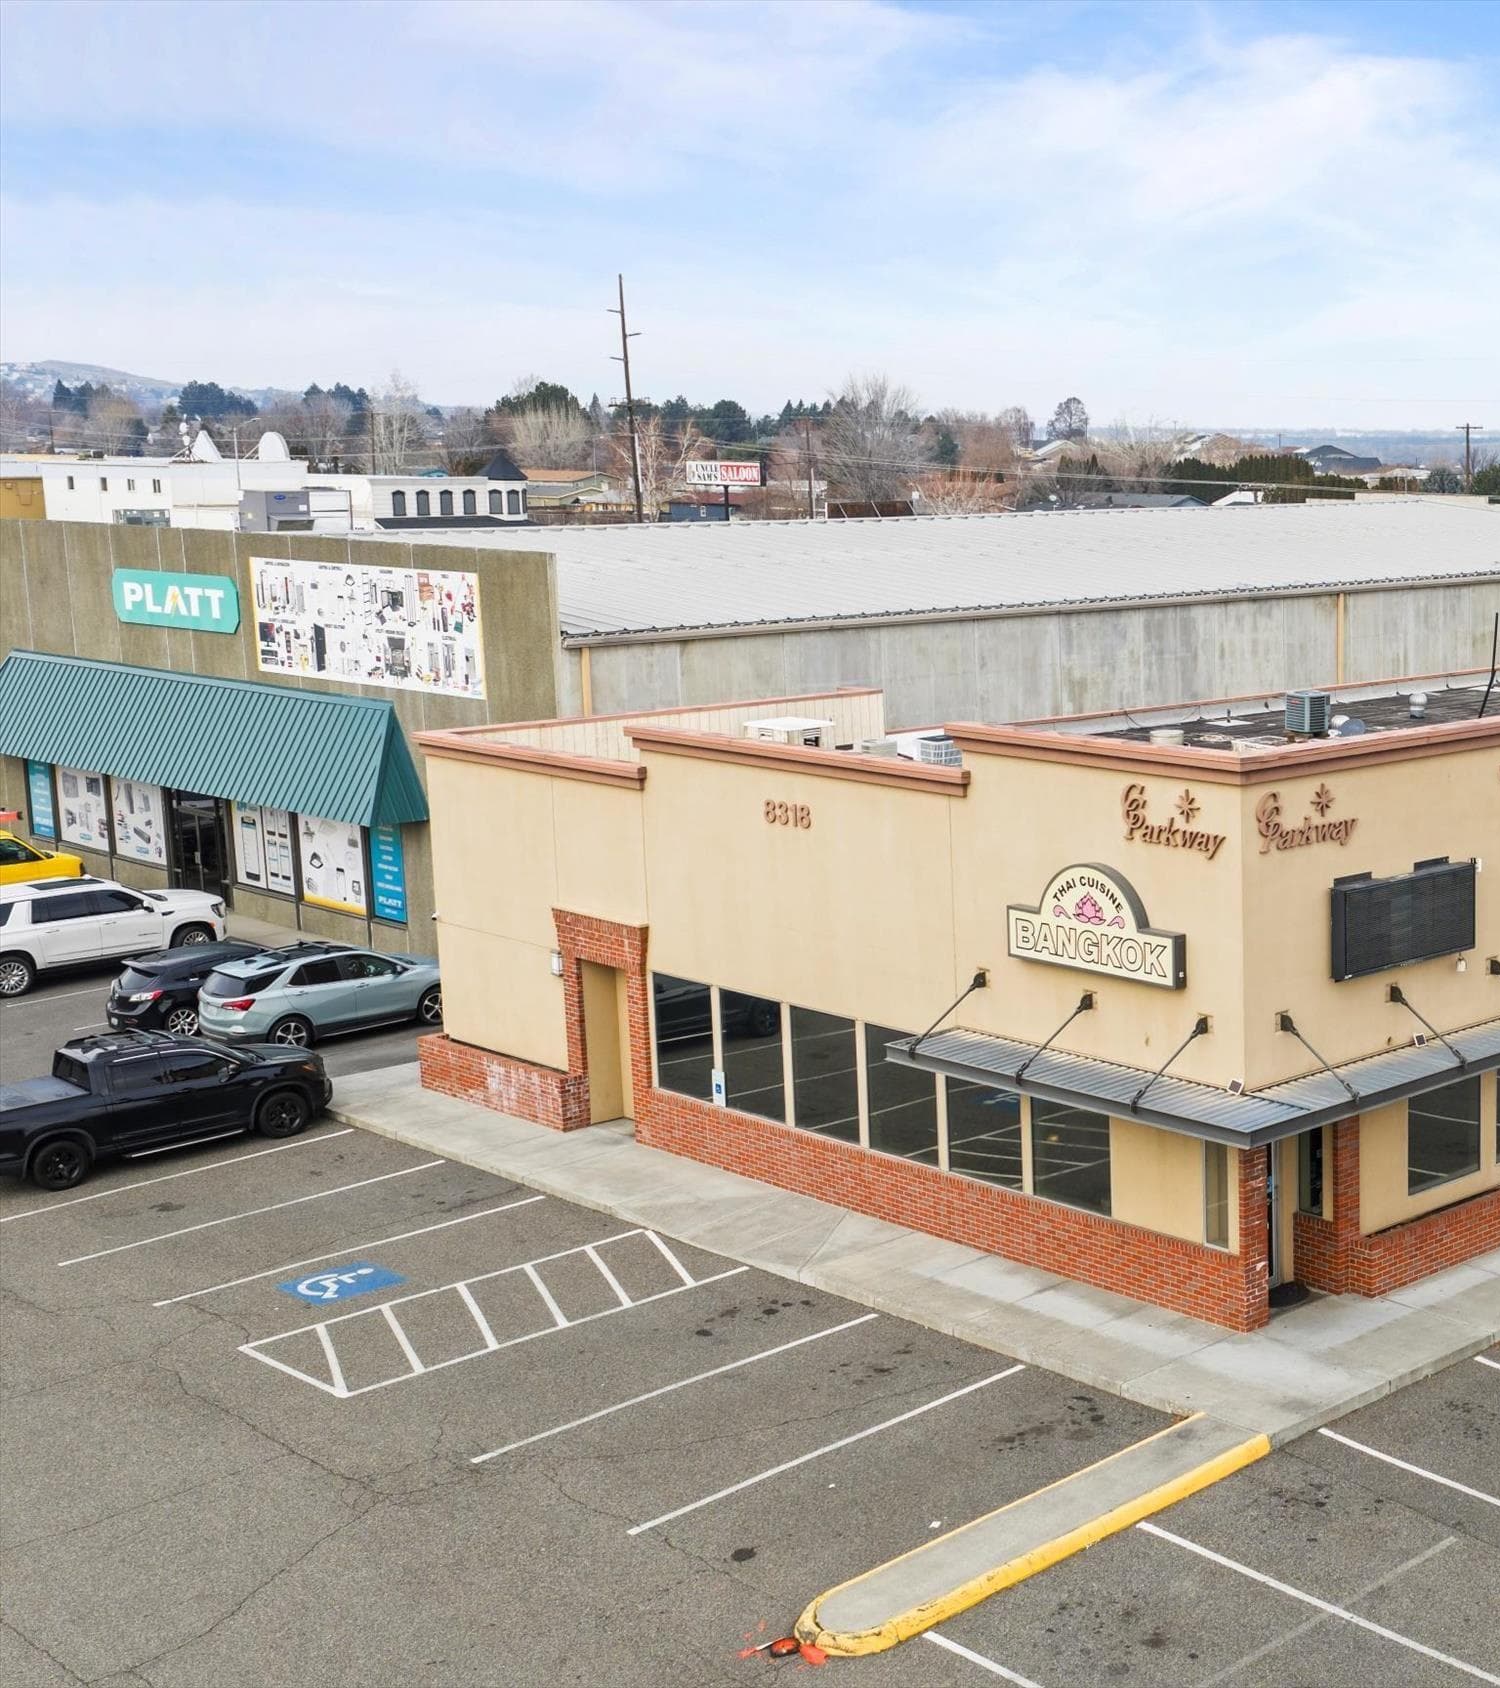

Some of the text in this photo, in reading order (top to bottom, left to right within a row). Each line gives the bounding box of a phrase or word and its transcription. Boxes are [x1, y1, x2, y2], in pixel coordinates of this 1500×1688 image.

[721, 466, 759, 482] SALOON
[123, 581, 225, 619] PLATT
[764, 799, 812, 829] 8318
[1123, 813, 1227, 861] Parkway
[1259, 817, 1359, 855] Parkway
[1052, 876, 1124, 914] THAI CUISINE
[1015, 917, 1168, 978] BANGKOK
